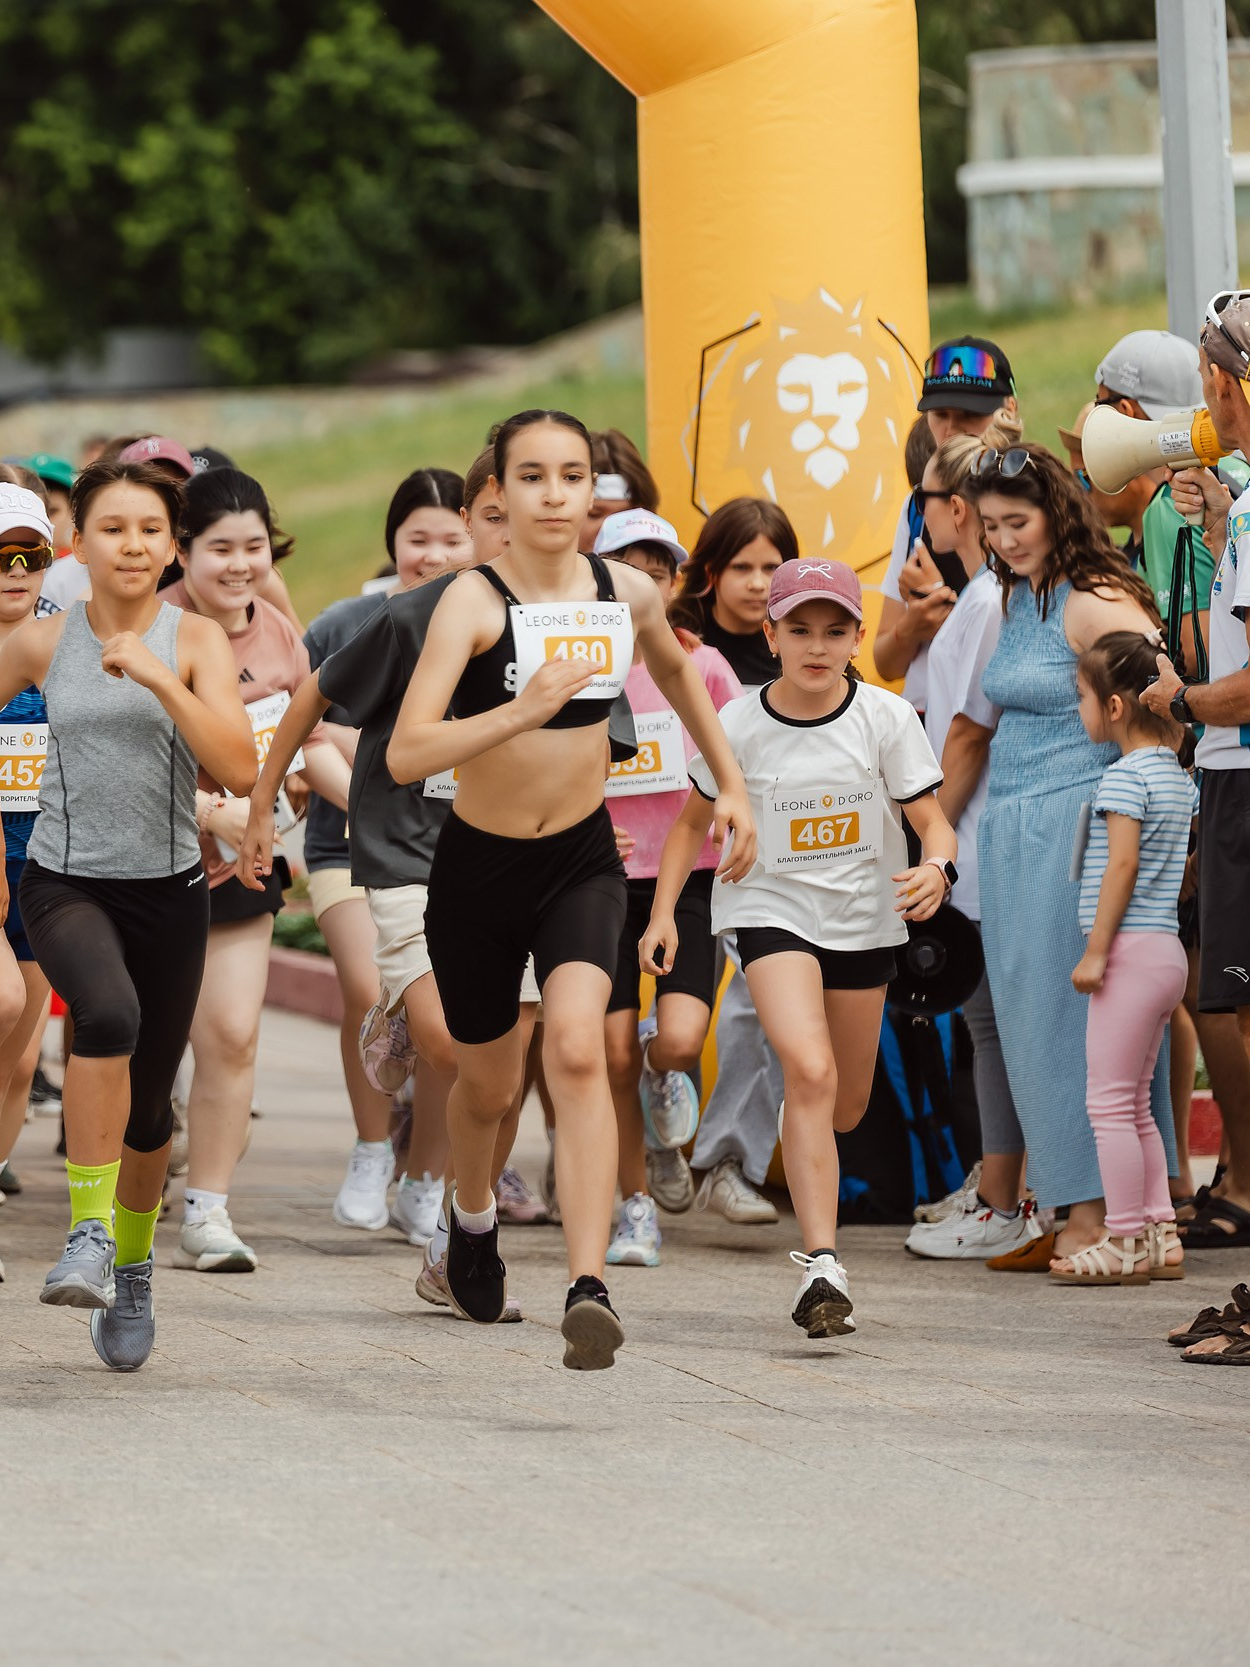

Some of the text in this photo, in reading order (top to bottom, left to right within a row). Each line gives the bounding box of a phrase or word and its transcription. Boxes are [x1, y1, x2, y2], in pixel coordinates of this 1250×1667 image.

[525, 615, 570, 627] LEONE
[774, 791, 874, 811] LEONE D'ORO
[797, 816, 852, 846] 467
[777, 845, 872, 864] БЛАГОТВОРИТЕЛЬНЫЙ ЗАБЕГ
